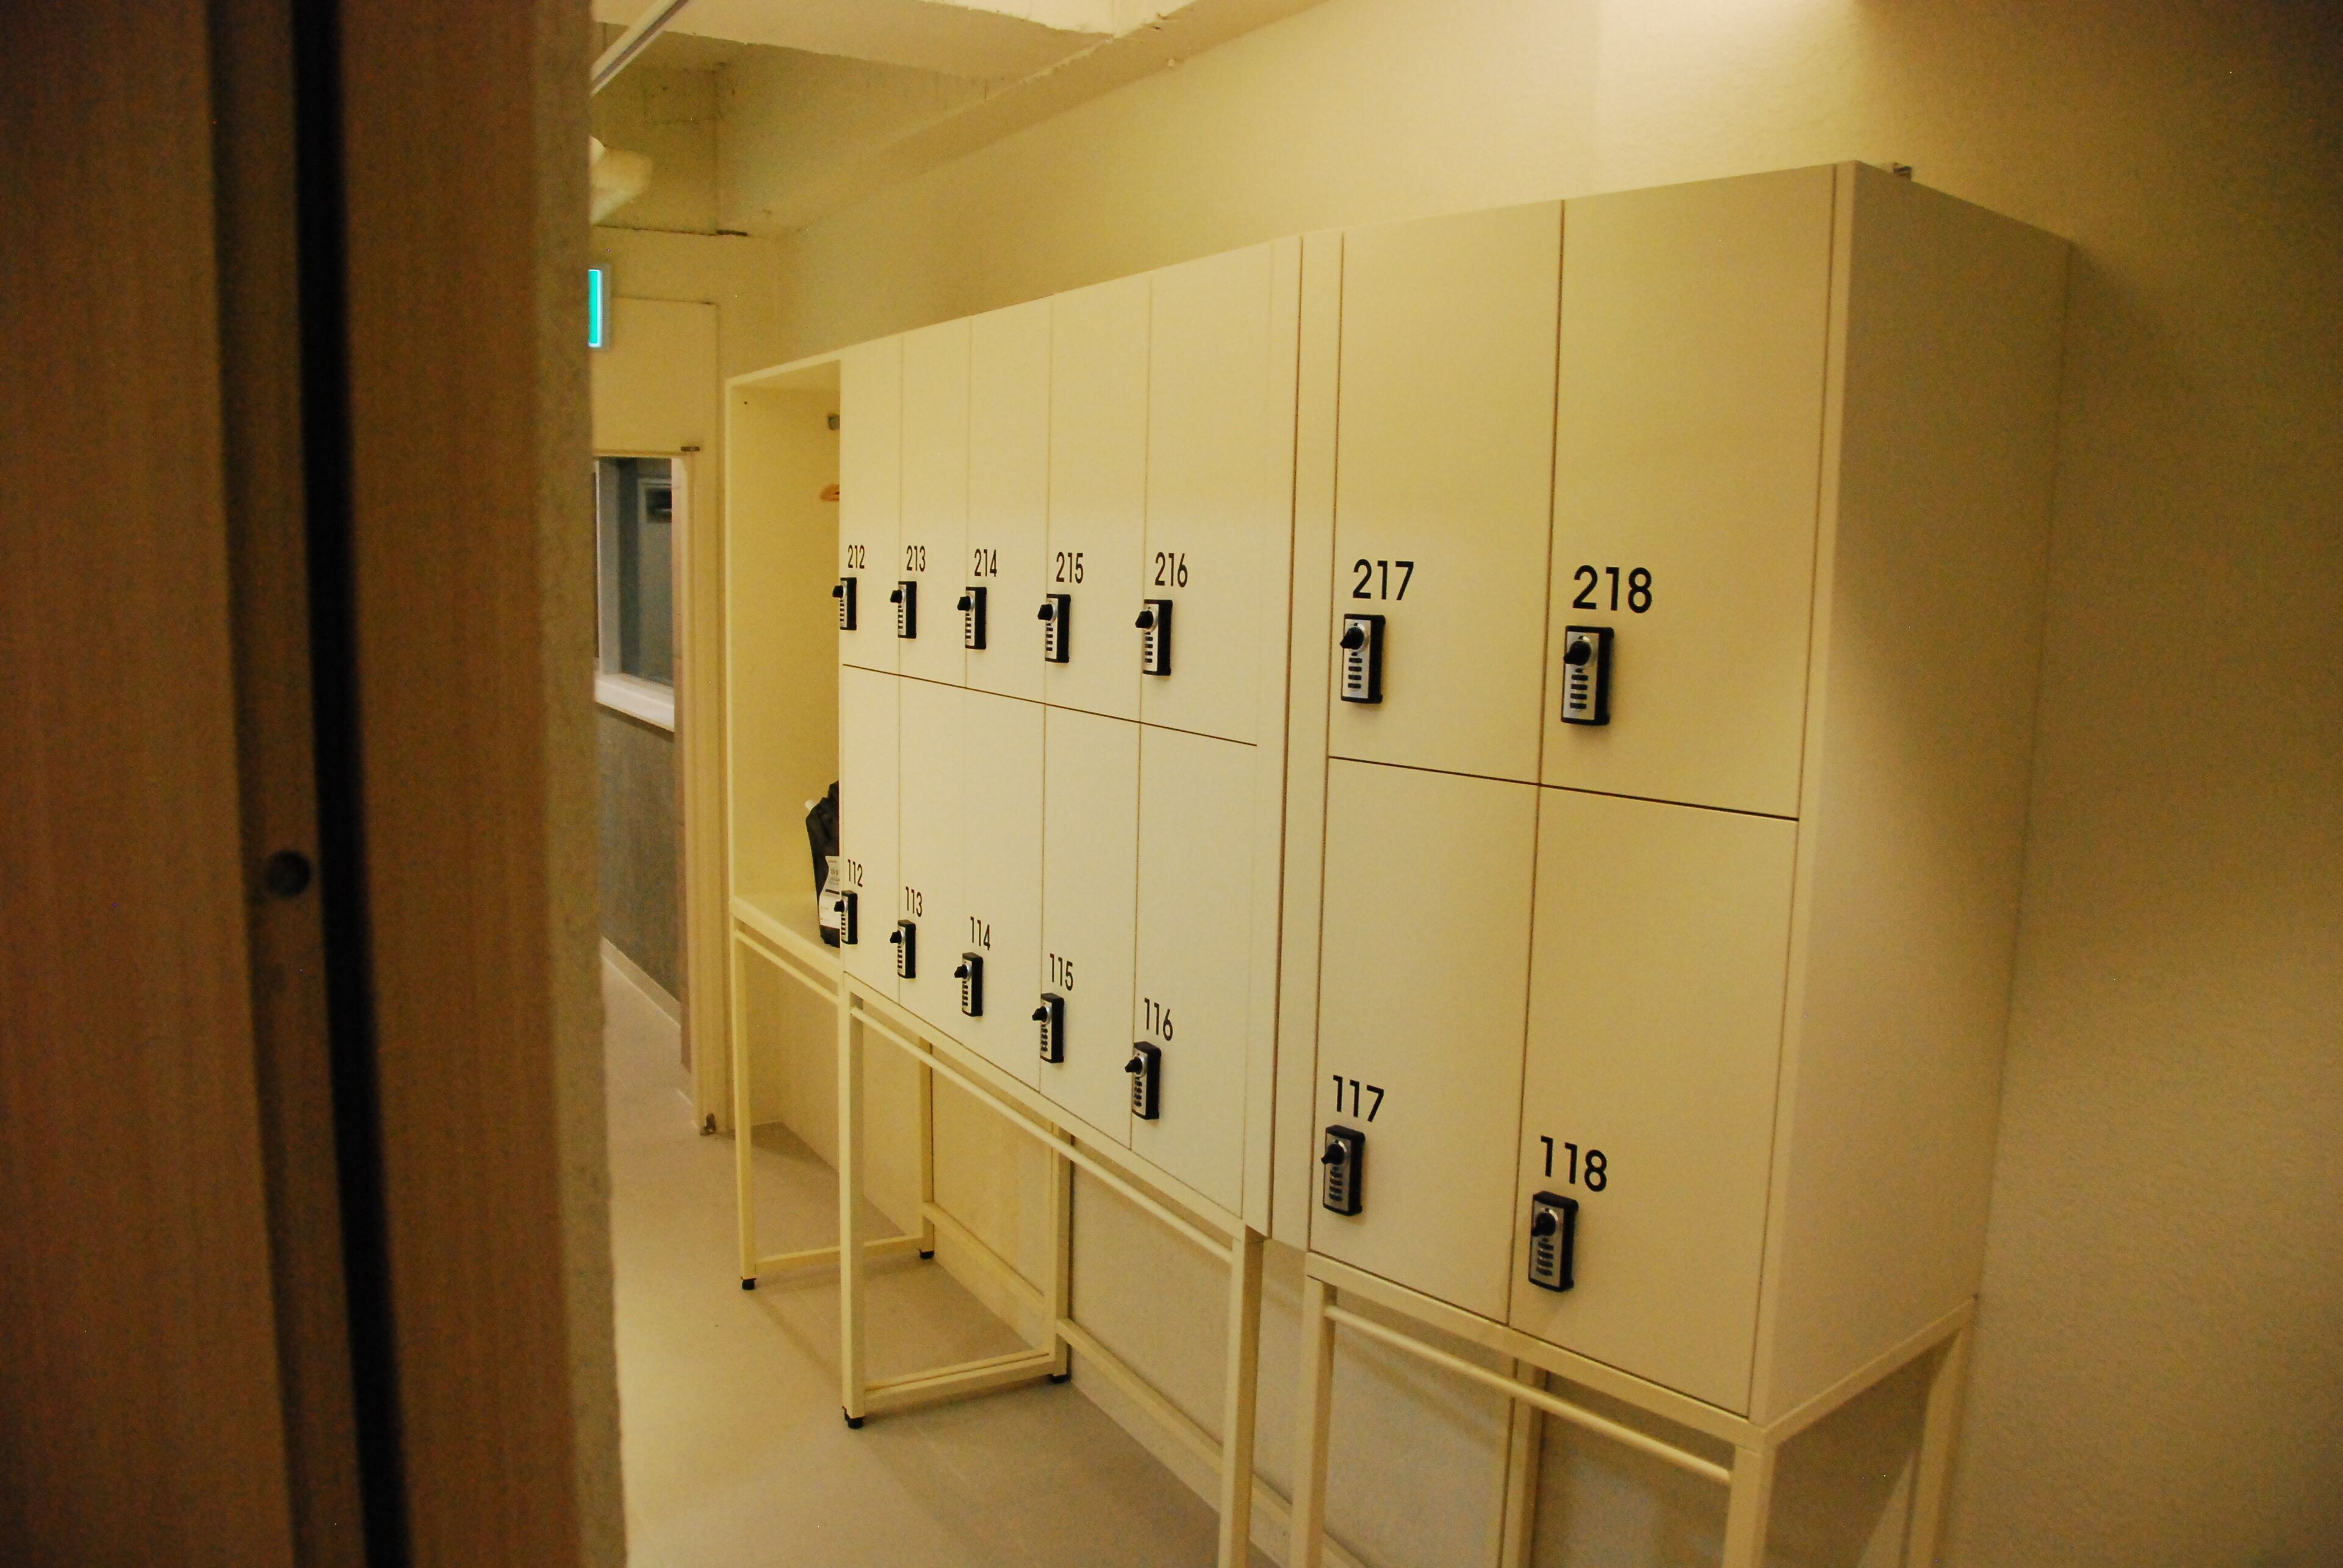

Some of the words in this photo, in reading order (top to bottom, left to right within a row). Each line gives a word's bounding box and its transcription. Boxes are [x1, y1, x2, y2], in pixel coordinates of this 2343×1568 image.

[848, 544, 865, 569] 212
[906, 545, 926, 572] 213
[974, 548, 998, 577] 214
[1056, 551, 1084, 584] 215
[1154, 552, 1188, 588] 216
[1352, 559, 1414, 601] 217
[1572, 564, 1652, 614] 218
[848, 859, 863, 888] 112
[905, 886, 923, 918] 113
[970, 916, 991, 951] 114
[1049, 953, 1074, 991] 115
[1144, 998, 1173, 1041] 116
[1333, 1074, 1384, 1123] 117
[1541, 1135, 1607, 1192] 118
